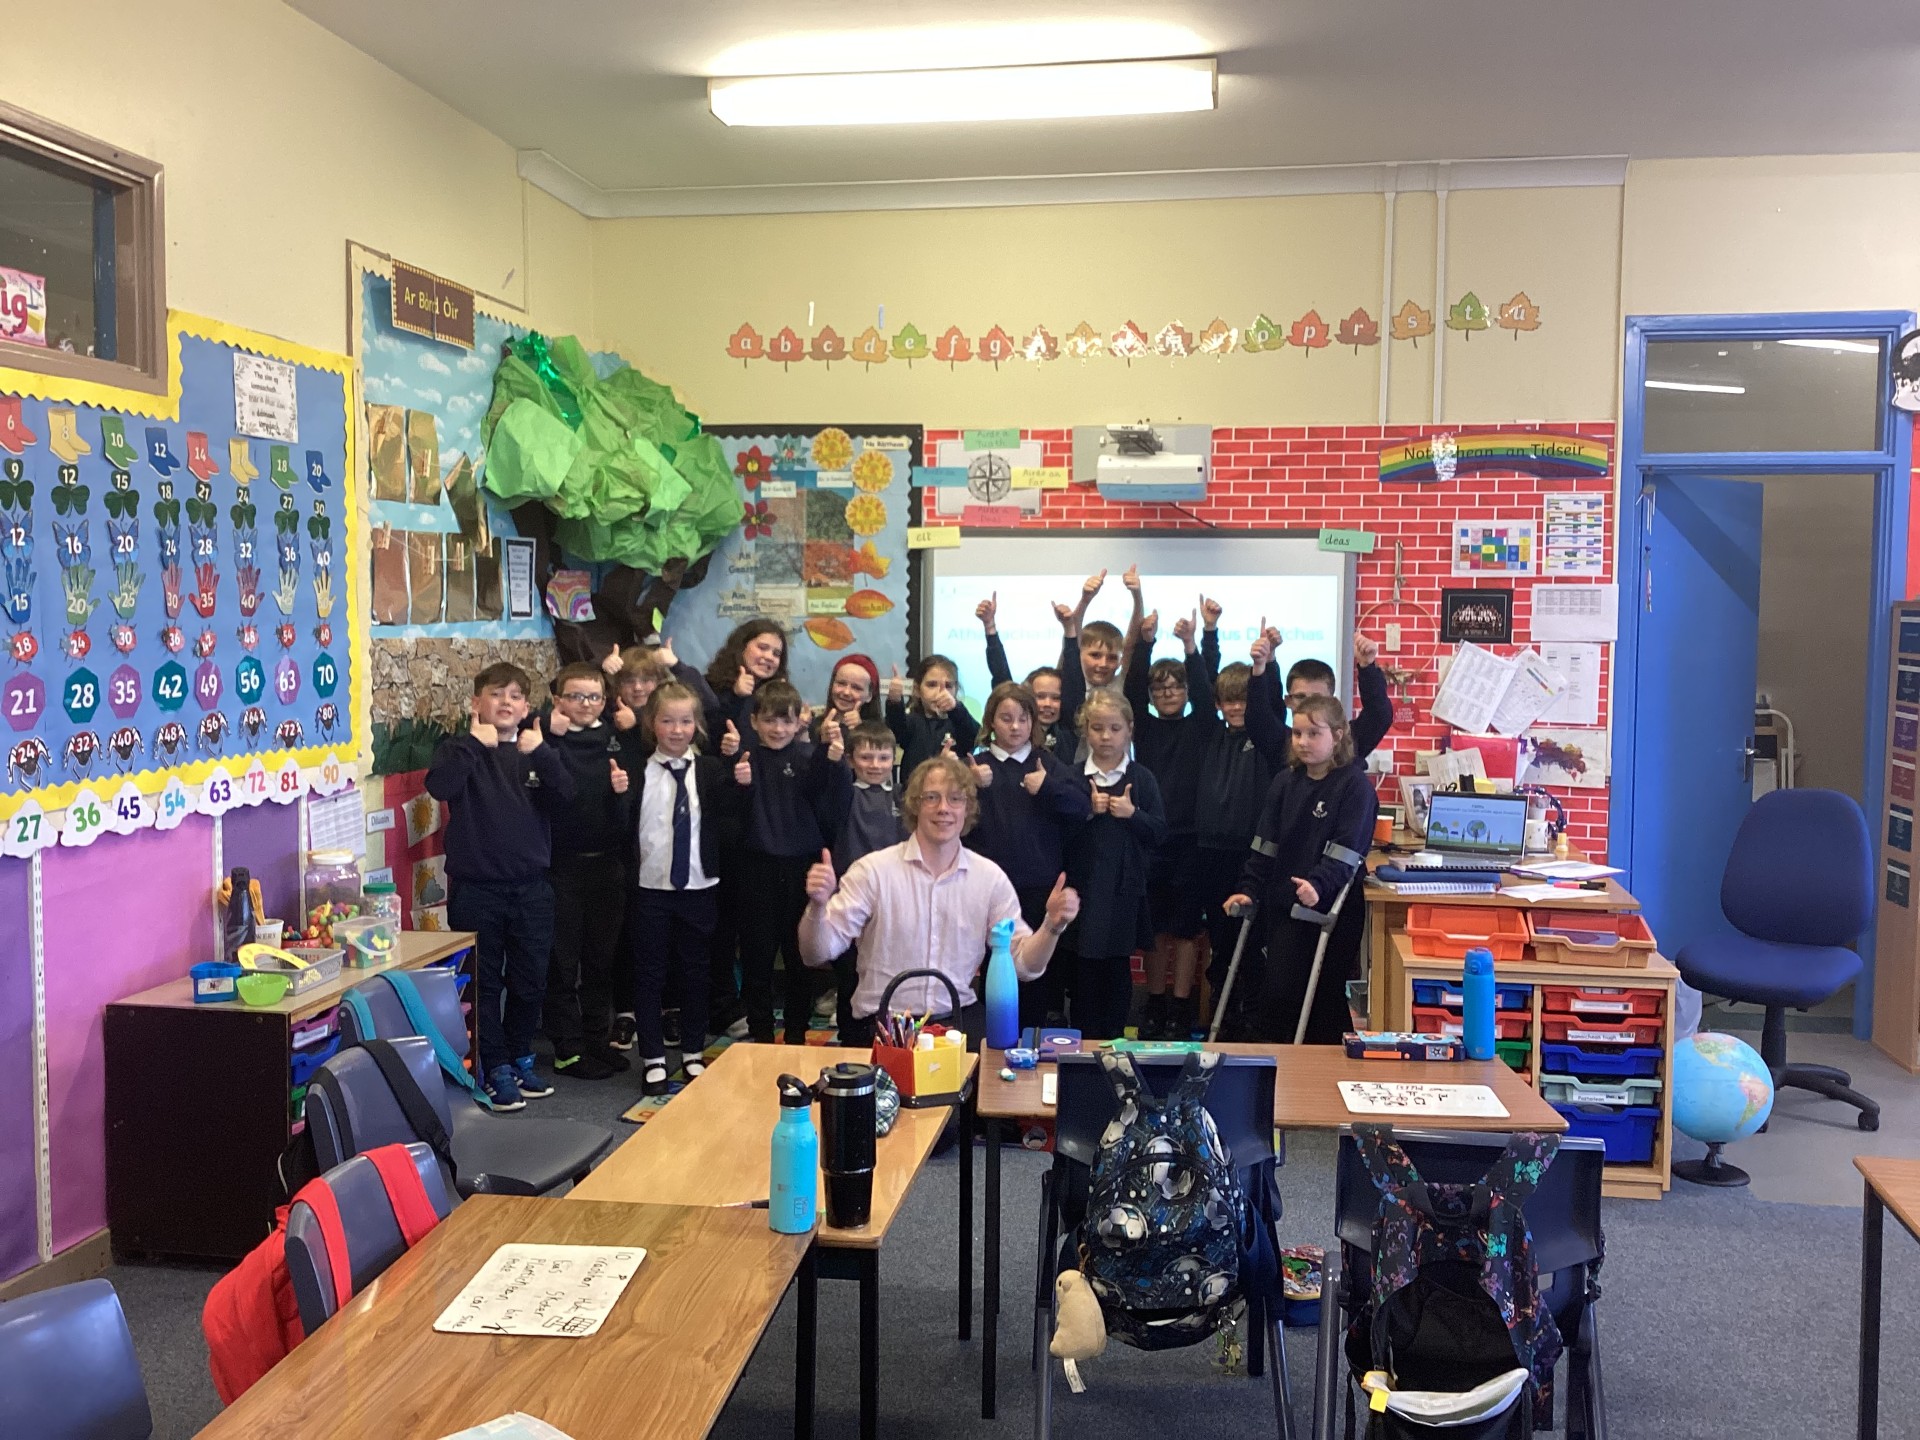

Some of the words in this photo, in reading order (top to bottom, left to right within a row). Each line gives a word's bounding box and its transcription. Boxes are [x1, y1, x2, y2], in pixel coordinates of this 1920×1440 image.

[404, 287, 416, 305] Ar
[443, 296, 459, 319] Òir
[741, 338, 752, 350] a
[780, 337, 791, 352] b
[824, 340, 833, 352] c
[864, 337, 875, 353] d
[905, 336, 915, 350] e
[947, 335, 959, 357] f
[989, 338, 1000, 356] g
[1257, 329, 1268, 342] o
[1303, 325, 1316, 343] p
[1353, 320, 1364, 335] r
[1407, 315, 1418, 328] s
[1464, 304, 1474, 321] t
[1513, 306, 1526, 321] u
[7, 414, 15, 430] 6
[61, 428, 70, 440] 8
[111, 432, 124, 448] 10
[154, 442, 167, 458] 12
[194, 447, 207, 463] 14
[277, 459, 288, 473] 18
[312, 463, 322, 478] 20
[1404, 445, 1494, 461] Nothean
[1506, 447, 1525, 457] an
[11, 462, 19, 479] 9
[62, 469, 76, 484] 12
[115, 474, 129, 490] 15
[160, 485, 172, 500] 18
[197, 486, 210, 499] 21
[238, 490, 249, 504] 24
[282, 496, 293, 509] 27
[314, 502, 325, 516] 30
[10, 528, 25, 546] 12
[65, 537, 82, 554] 16
[118, 536, 134, 552] 20
[165, 540, 177, 556] 24
[198, 539, 213, 555] 28
[240, 542, 252, 558] 32
[284, 546, 296, 561] 36
[317, 551, 331, 566] 40
[1325, 534, 1350, 546] deas
[14, 594, 28, 611] 15
[68, 598, 86, 614] 20
[121, 592, 135, 608] 25
[166, 592, 178, 609] 30
[200, 592, 214, 607] 35
[241, 595, 255, 609] 40
[732, 592, 746, 600] Am
[16, 637, 31, 654] 18
[70, 637, 85, 652] 24
[118, 631, 132, 646] 30
[168, 631, 181, 647] 36
[202, 634, 214, 651] 42
[244, 630, 256, 644] 48
[282, 628, 293, 642] 54
[10, 688, 38, 715] 21
[71, 683, 95, 708] 28
[114, 680, 137, 705] 35
[158, 674, 183, 698] 42
[200, 673, 218, 697] 49
[240, 669, 260, 693] 56
[279, 668, 296, 692] 63
[317, 665, 335, 687] 70
[17, 745, 36, 764] 24
[76, 736, 91, 753] 32
[116, 731, 132, 747] 40
[163, 727, 177, 742] 48
[205, 717, 219, 733] 56
[282, 723, 295, 737] 72
[321, 706, 333, 720] 80
[16, 814, 42, 843] 27
[72, 805, 101, 832] 36
[117, 796, 141, 820] 45
[164, 792, 186, 816] 54
[209, 780, 232, 803] 63
[248, 771, 267, 793] 72
[280, 770, 299, 792] 81
[323, 764, 339, 783] 90
